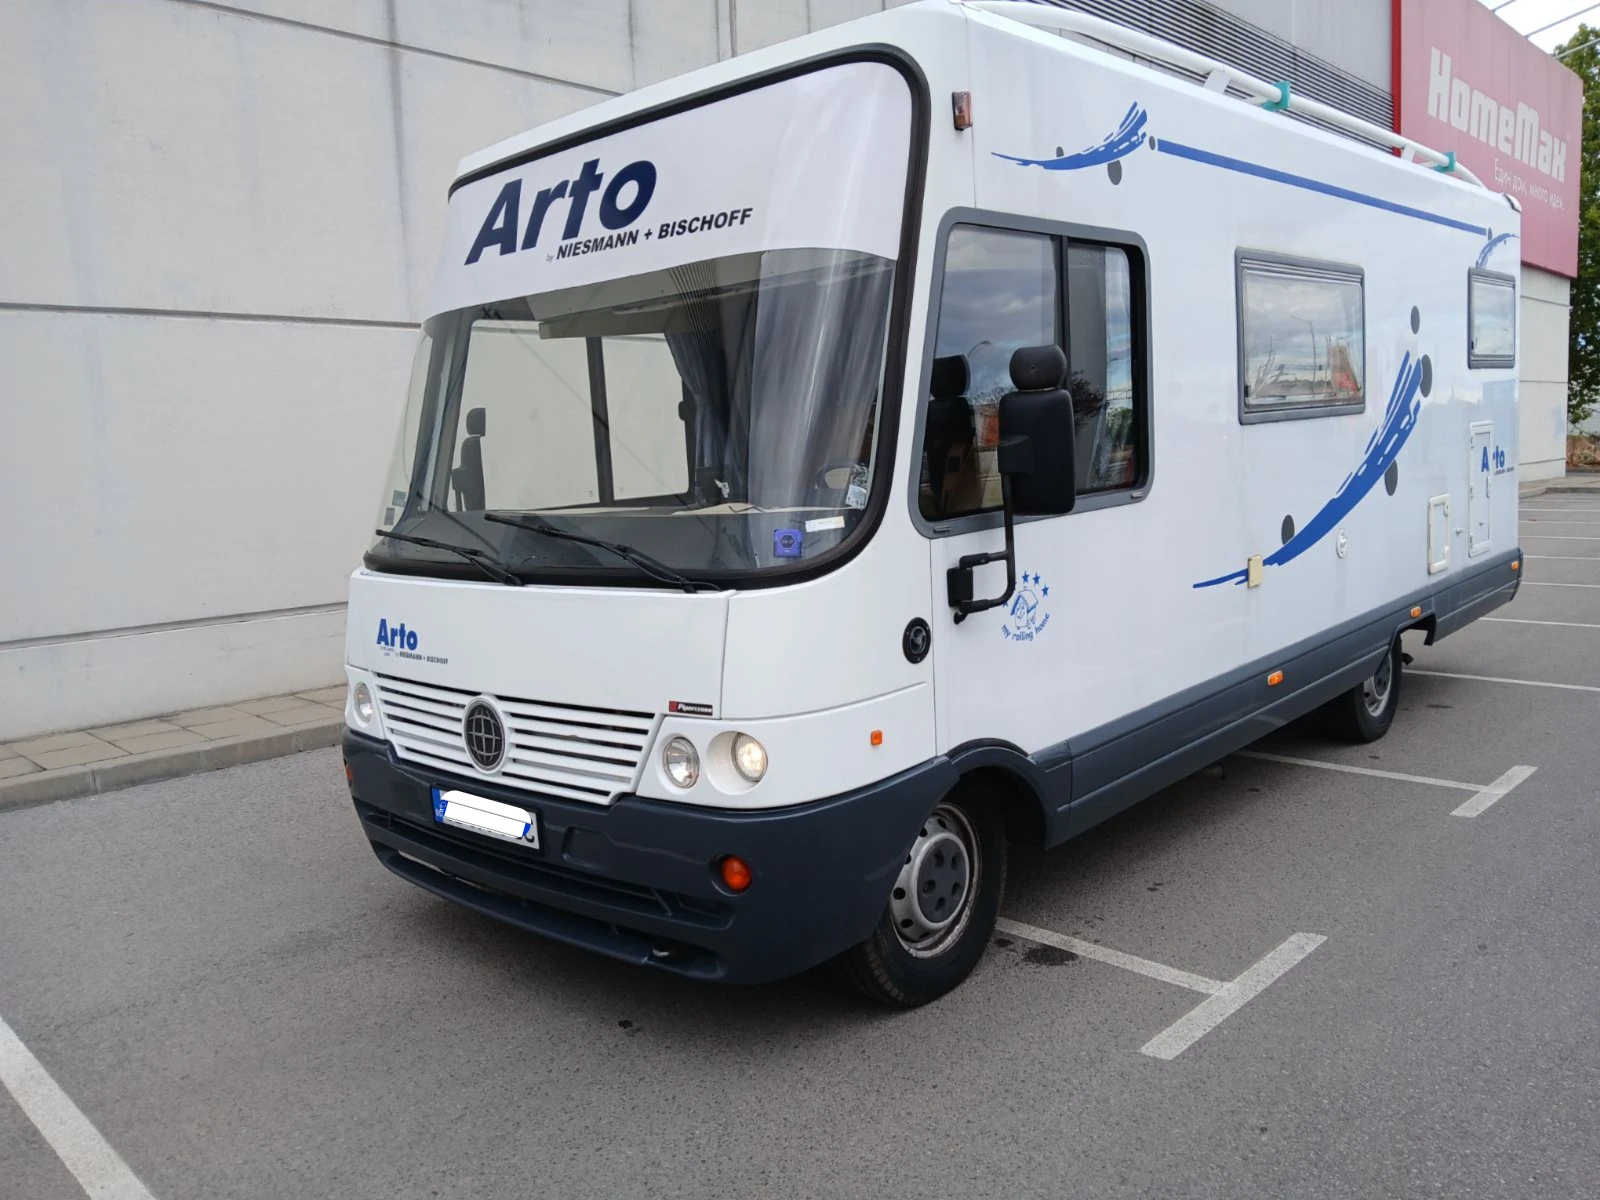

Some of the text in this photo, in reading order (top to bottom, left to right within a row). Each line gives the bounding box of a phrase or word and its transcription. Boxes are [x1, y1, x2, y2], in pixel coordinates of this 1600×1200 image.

[1427, 46, 1567, 183] HomeMax
[1494, 157, 1512, 187] Един
[463, 158, 657, 266] Arto
[546, 207, 753, 263] by NIESMANN + BISCHOFF
[376, 618, 418, 651] Arto
[1001, 612, 1050, 641] my rolling home
[426, 656, 449, 665] BISCHOFF
